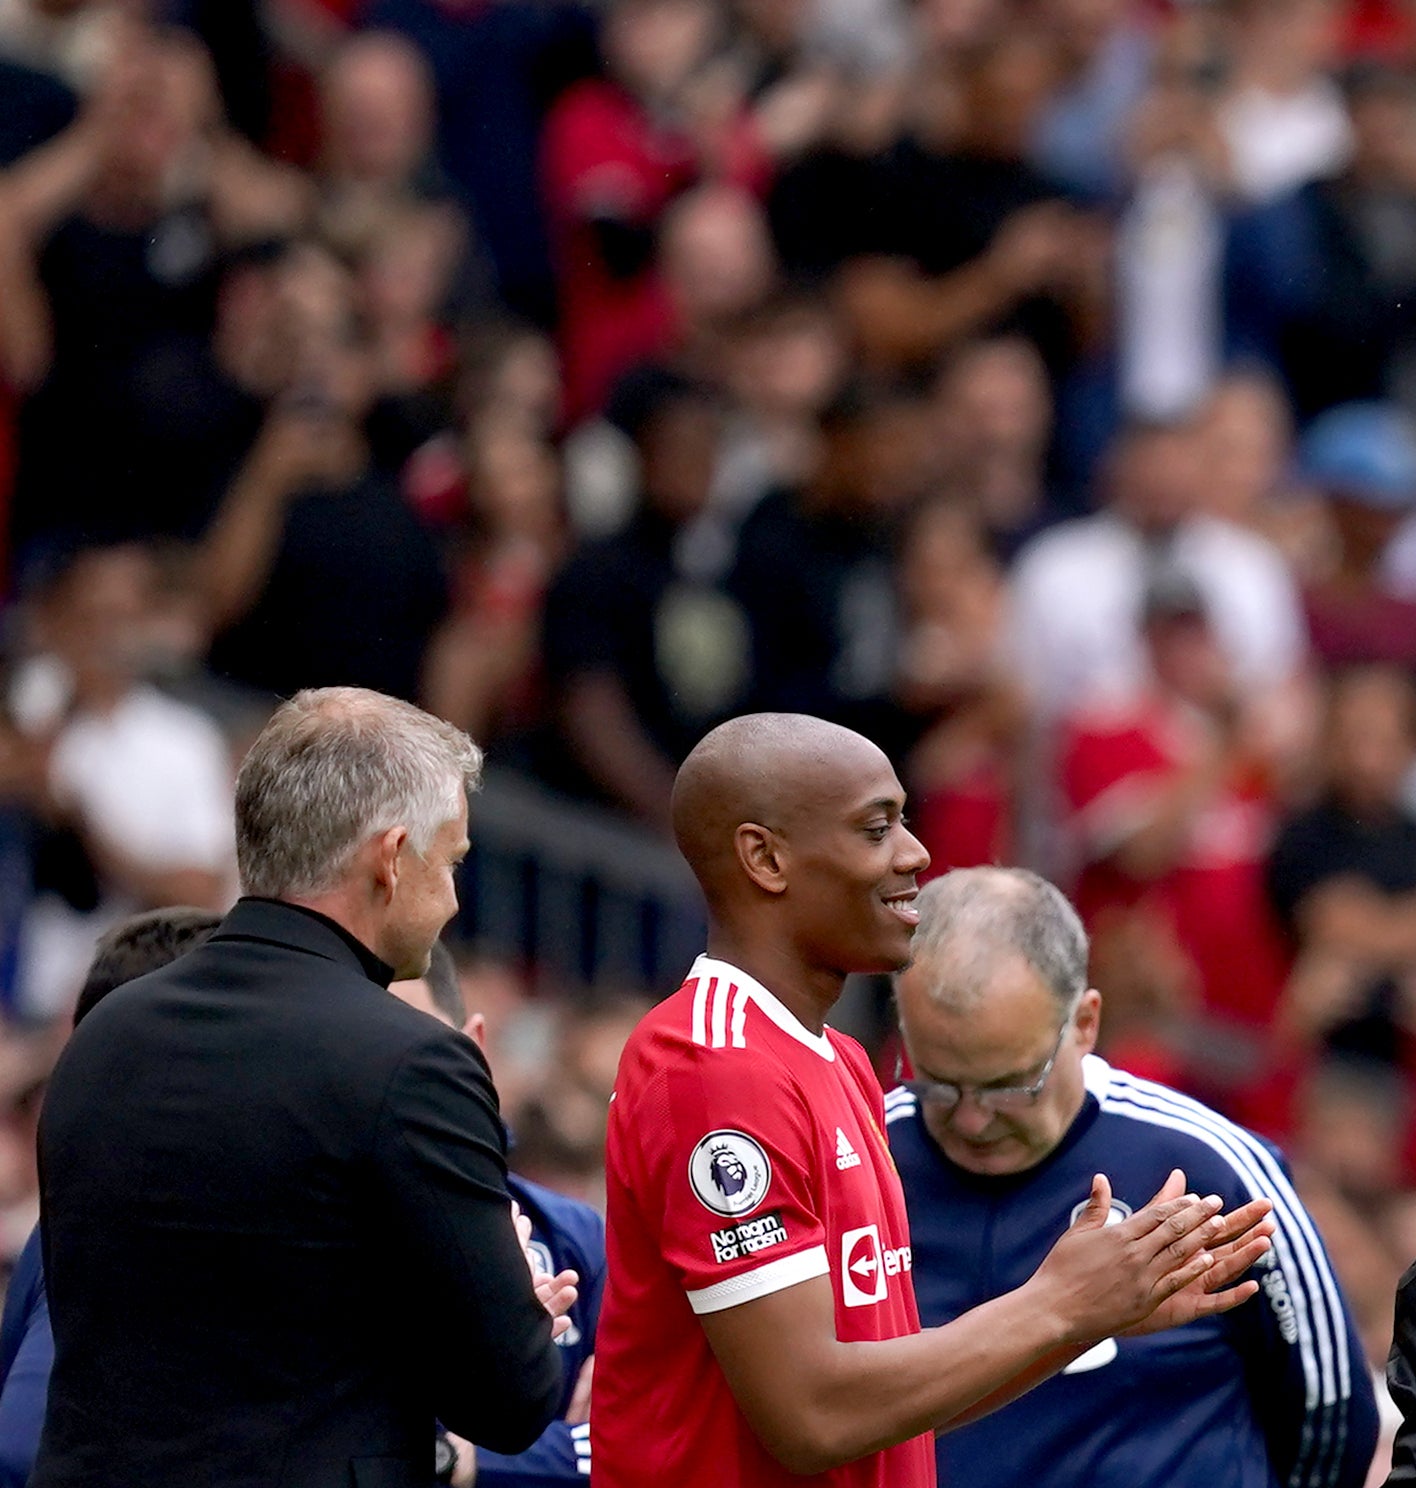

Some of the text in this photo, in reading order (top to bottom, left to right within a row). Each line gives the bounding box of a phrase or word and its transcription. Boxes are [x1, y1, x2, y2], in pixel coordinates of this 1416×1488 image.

[710, 1215, 779, 1249] No room
[739, 1225, 788, 1255] racism
